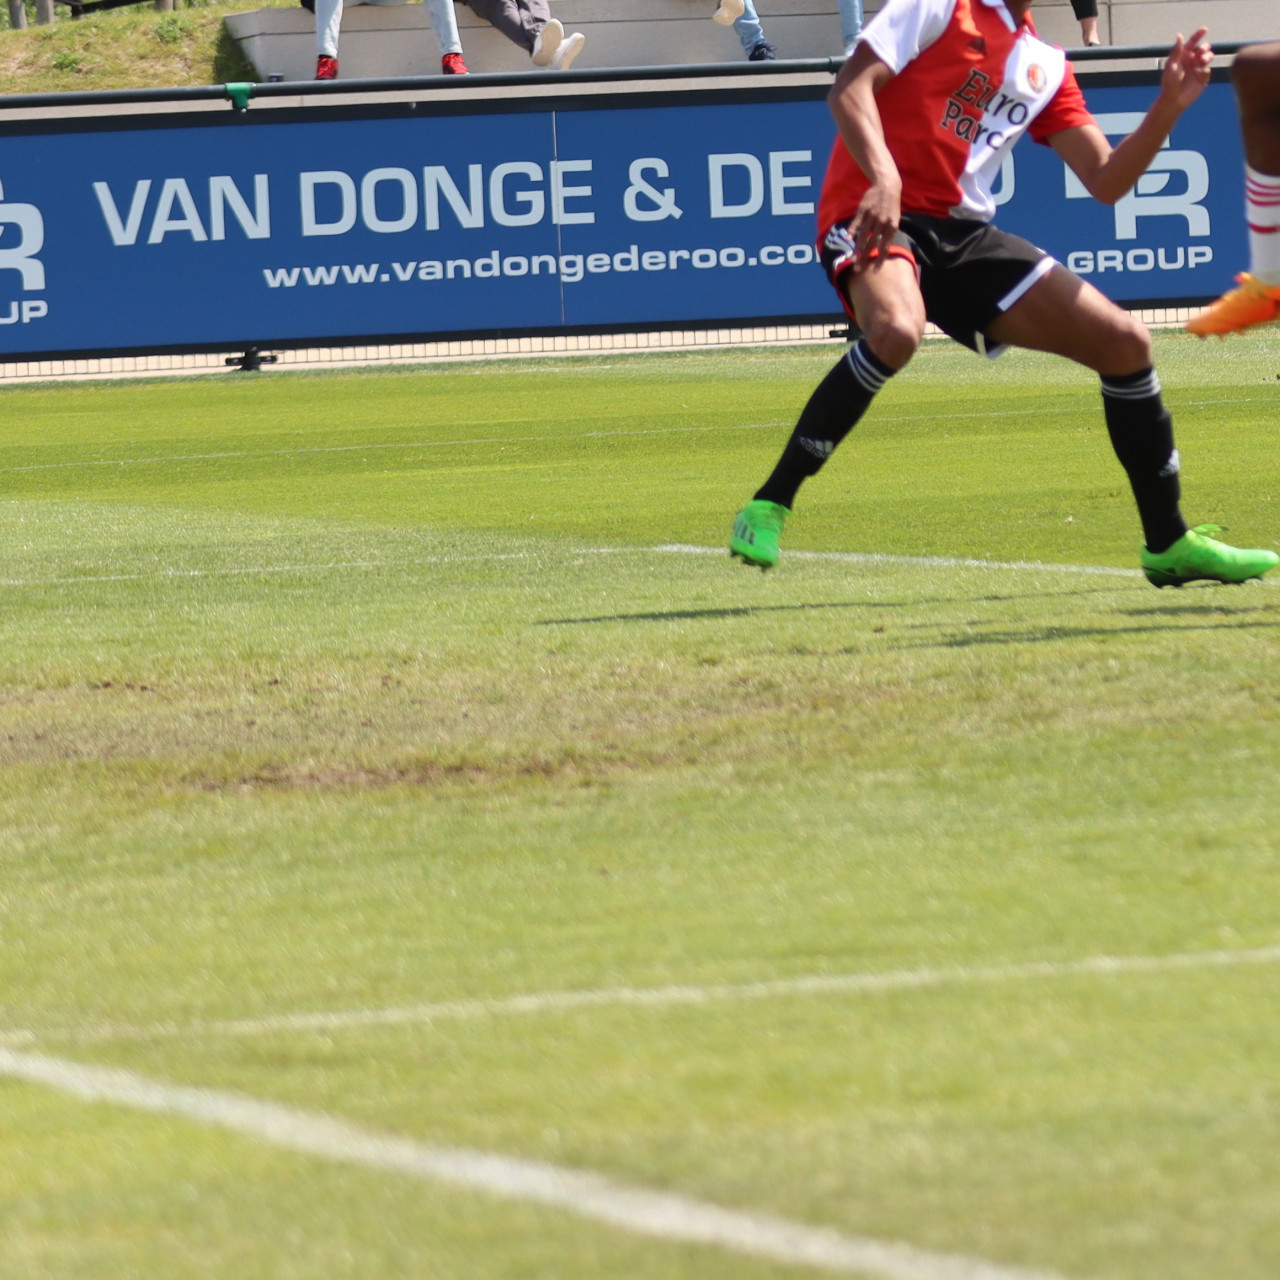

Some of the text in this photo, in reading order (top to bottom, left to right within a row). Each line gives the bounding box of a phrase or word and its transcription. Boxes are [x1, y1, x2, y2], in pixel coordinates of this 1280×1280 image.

[953, 67, 1029, 125] Euro
[940, 98, 1013, 150] Parc
[93, 150, 816, 246] VAN DONGE & DE
[263, 243, 820, 288] www.vandongederoo.co
[1067, 245, 1214, 274] GROUP
